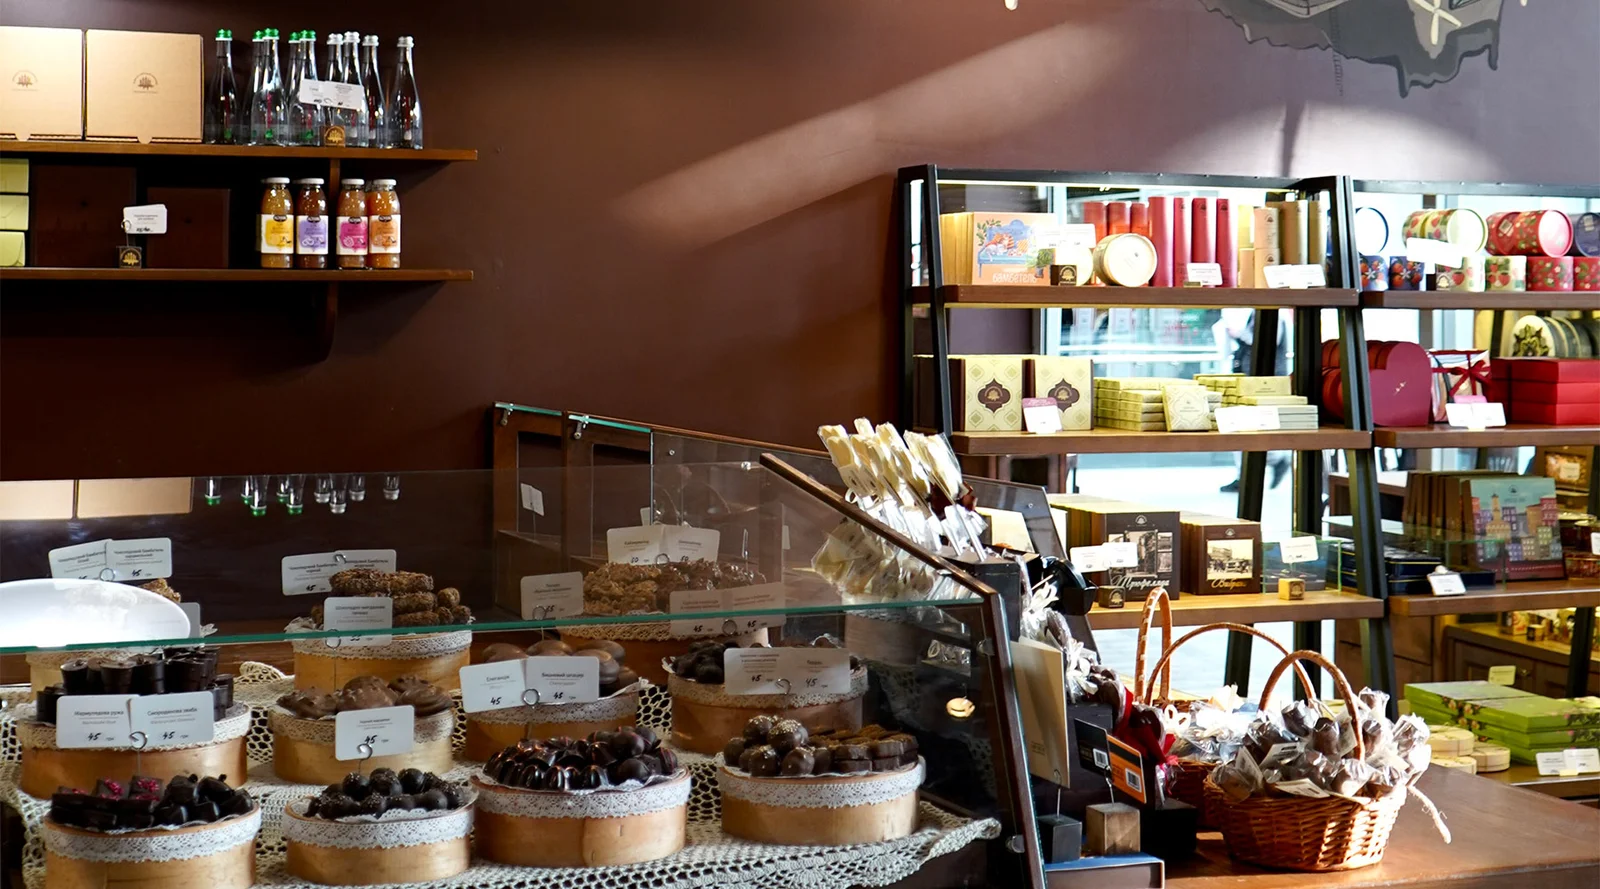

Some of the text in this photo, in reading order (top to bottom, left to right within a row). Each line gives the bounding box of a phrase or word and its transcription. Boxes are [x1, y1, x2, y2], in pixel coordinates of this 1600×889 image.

[805, 678, 817, 688] 45
[490, 696, 502, 705] 45
[553, 692, 564, 700] 45
[87, 732, 102, 741] 45
[162, 731, 175, 740] 45
[364, 734, 378, 744] 45
